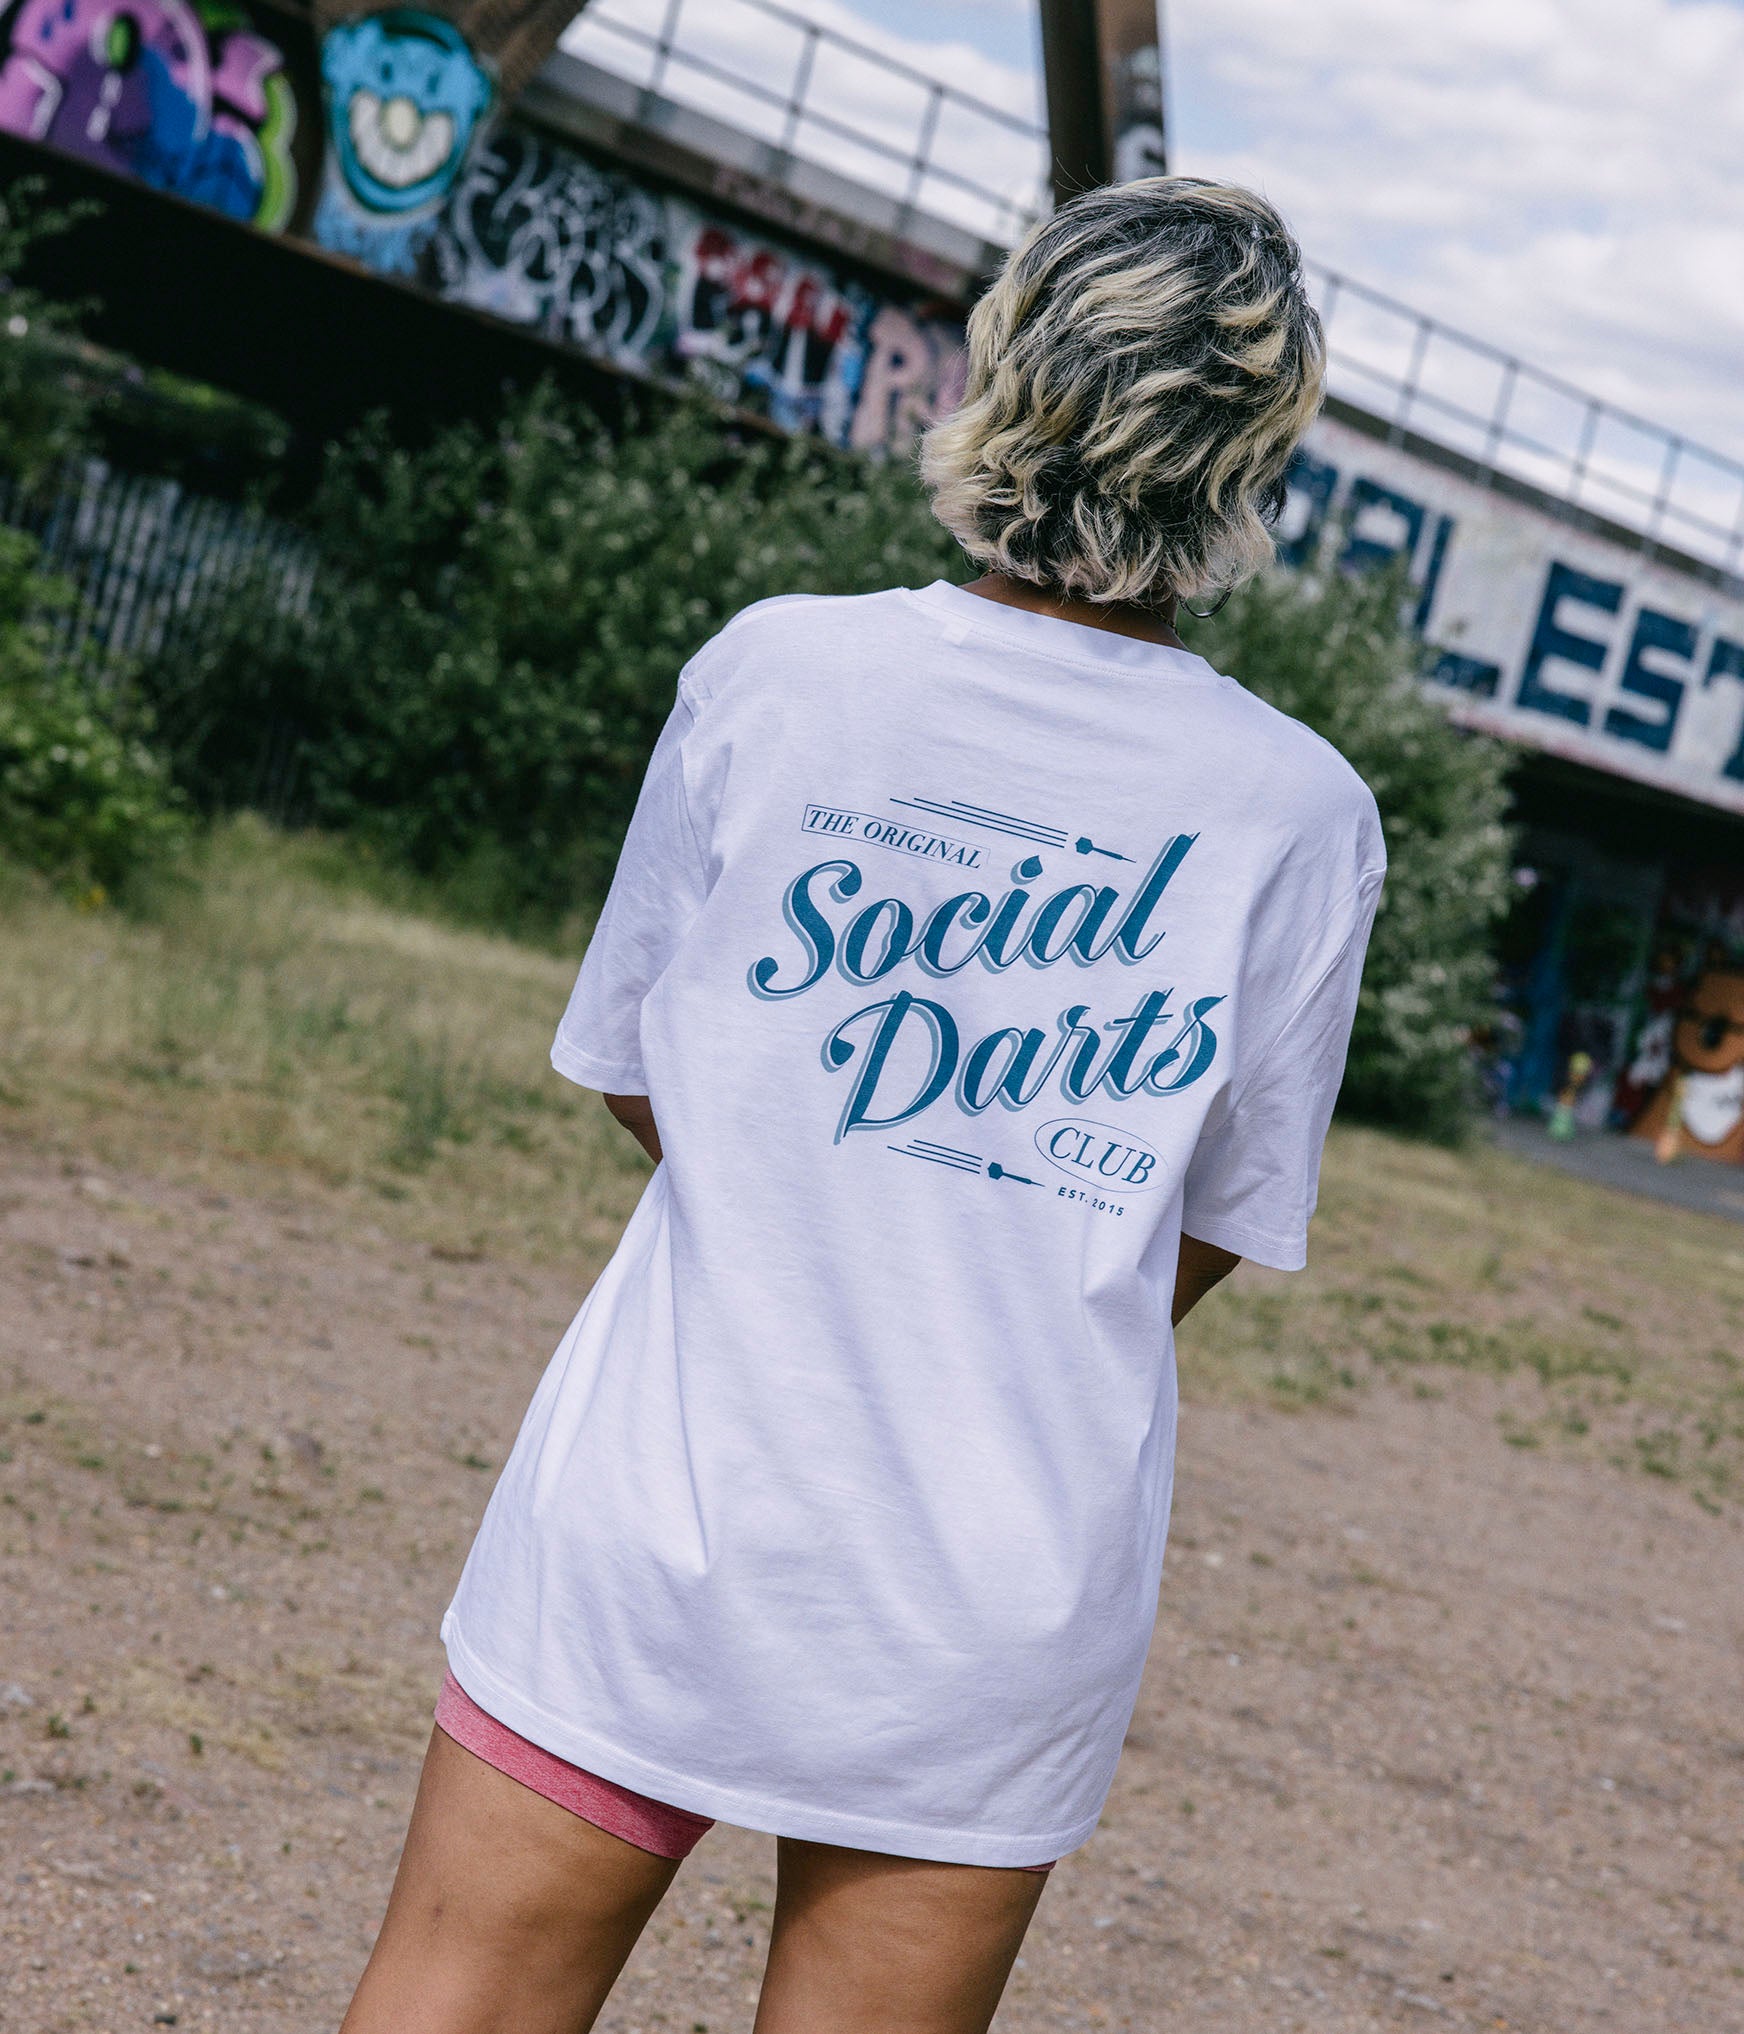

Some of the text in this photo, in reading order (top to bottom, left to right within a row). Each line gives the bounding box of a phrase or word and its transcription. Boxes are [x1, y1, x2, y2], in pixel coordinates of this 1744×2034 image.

[807, 809, 982, 870] THE ORIGINAL
[746, 832, 1201, 1001] Social
[820, 987, 1228, 1145] Darts
[1049, 1126, 1157, 1185] CLUB
[1091, 1198, 1125, 1216] 2015
